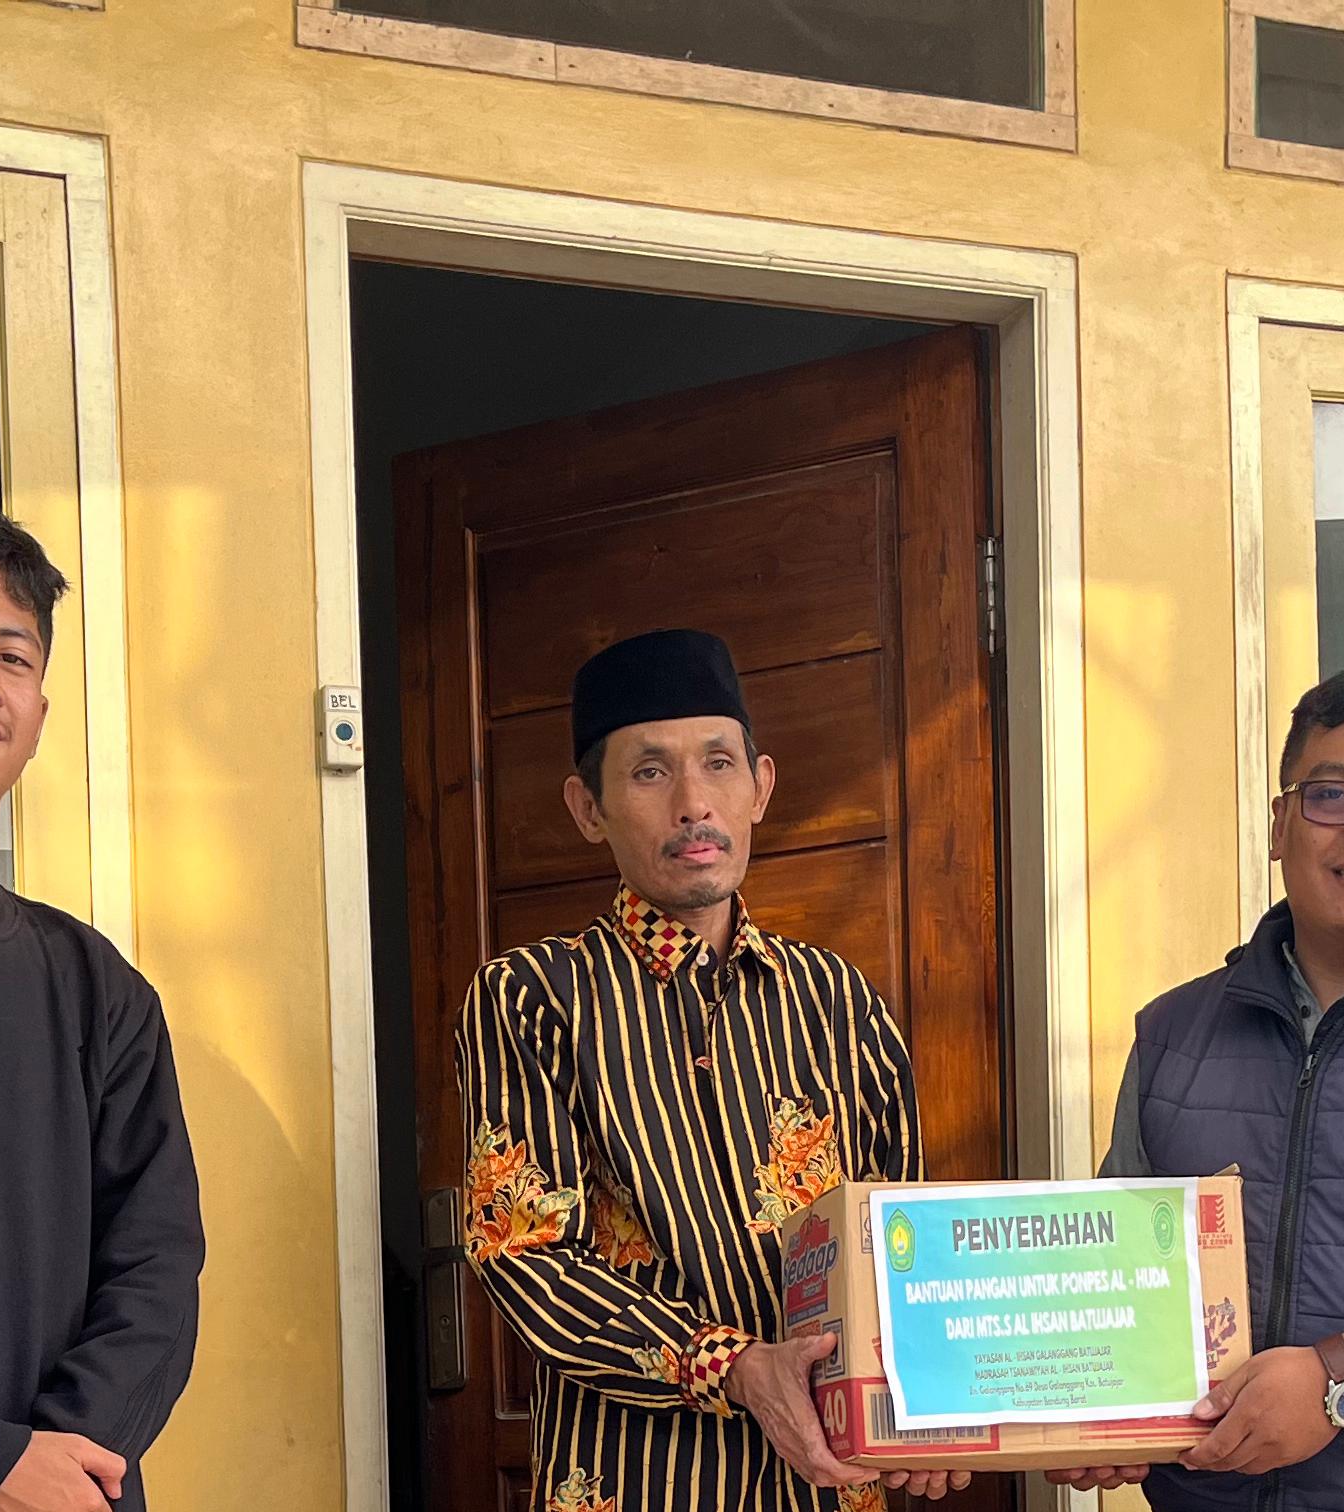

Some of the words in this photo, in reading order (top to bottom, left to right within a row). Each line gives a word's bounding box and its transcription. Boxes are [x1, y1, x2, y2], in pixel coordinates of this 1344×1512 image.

[330, 694, 357, 709] BEL
[952, 1211, 1116, 1254] PENYERAHAN
[906, 1278, 965, 1304] BANTUAN
[966, 1275, 1017, 1300] PANGAN
[1019, 1273, 1060, 1297] UNTUK
[1062, 1271, 1109, 1295] PONPES
[1109, 1269, 1127, 1291] AL
[1135, 1267, 1170, 1290] HUDA
[945, 1316, 974, 1341] DARI
[976, 1313, 1012, 1339] MTS.S
[1013, 1313, 1030, 1336] AL
[1031, 1310, 1070, 1335] IHSAN
[1070, 1306, 1136, 1332] BATUJAJAR
[974, 1353, 1004, 1364] YAYASAN
[1036, 1347, 1078, 1361] GALANGGANG
[1079, 1345, 1112, 1357] BATUJAJAR
[974, 1368, 1008, 1380] MADRASAH
[1082, 1361, 1114, 1373] BATUJAJAR
[824, 1388, 847, 1437] 40
